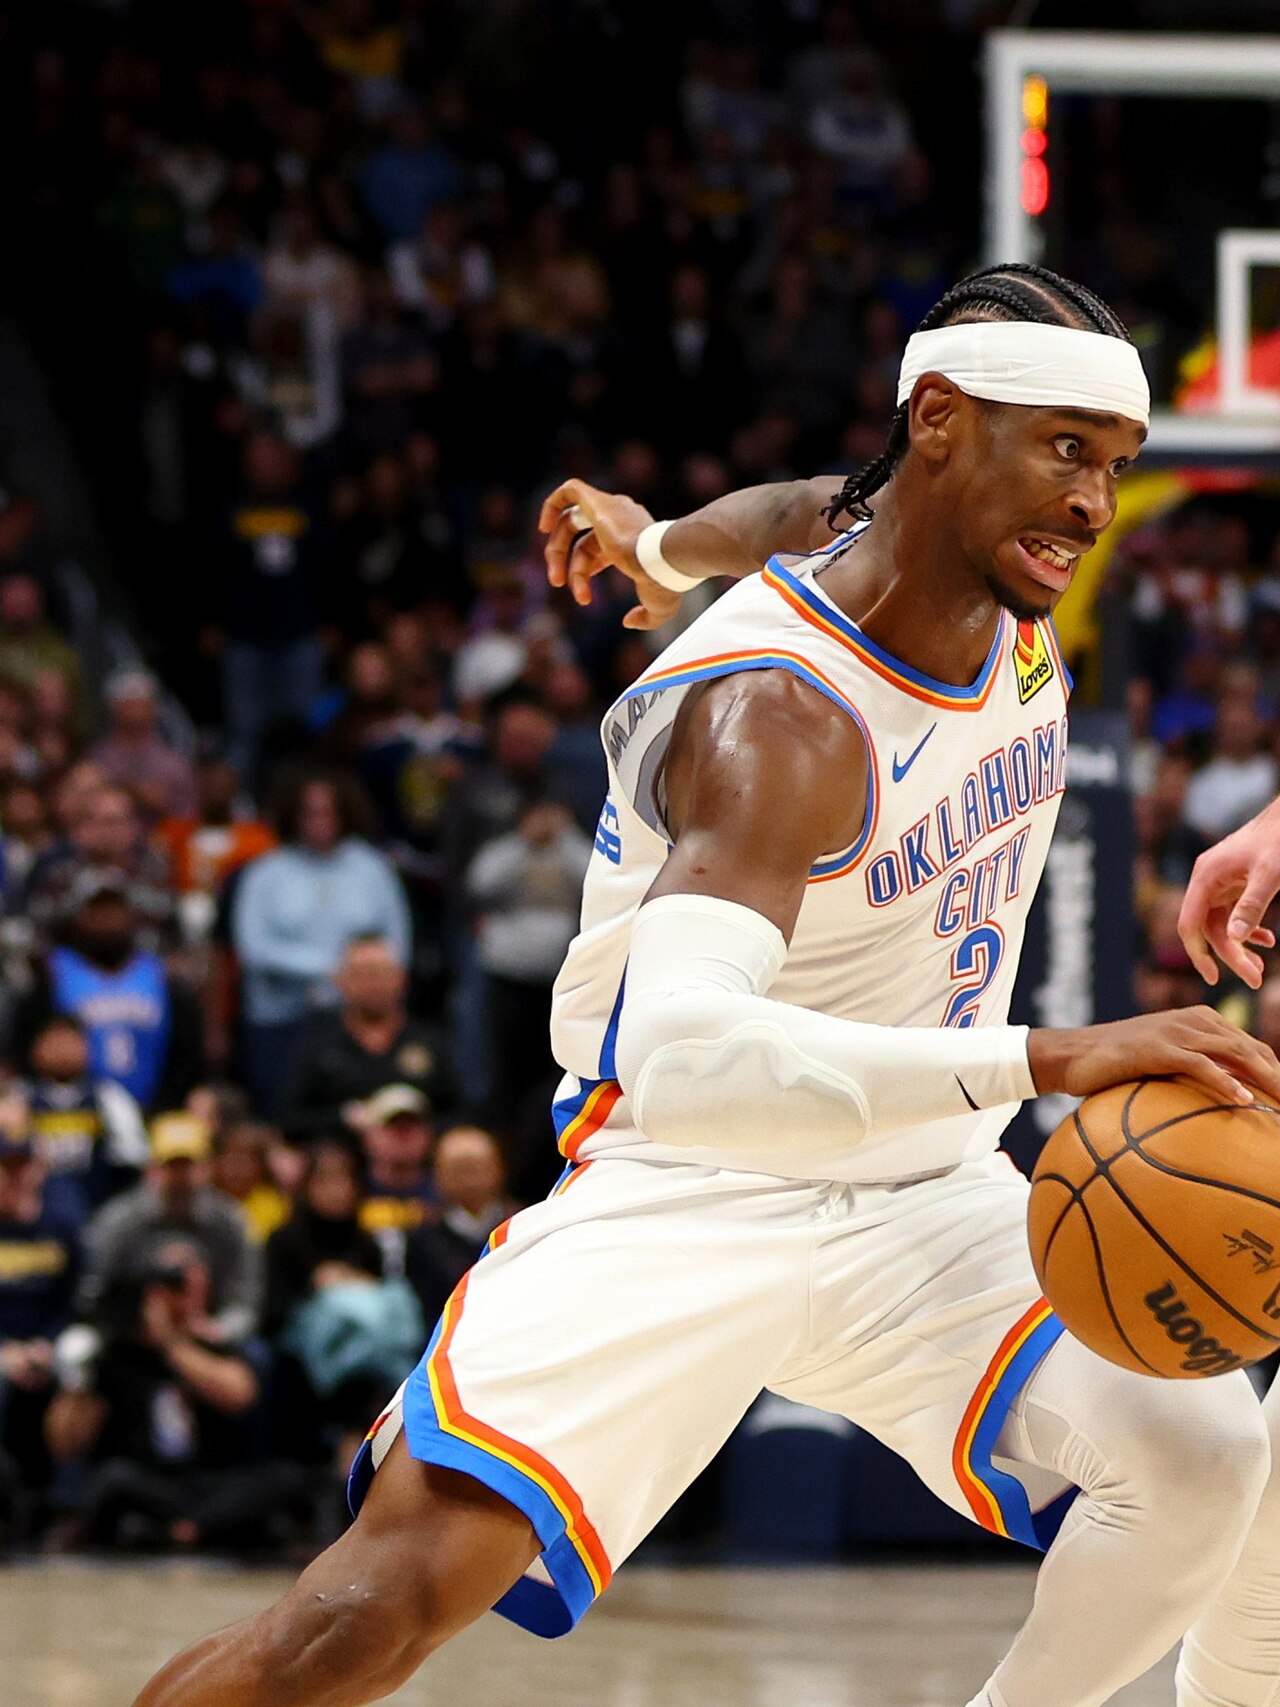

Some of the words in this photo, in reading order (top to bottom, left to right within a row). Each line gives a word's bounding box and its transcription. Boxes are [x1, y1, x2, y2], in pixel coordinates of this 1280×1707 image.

[1020, 654, 1049, 696] Love's
[934, 823, 1031, 938] CITY
[942, 919, 1005, 1028] 2
